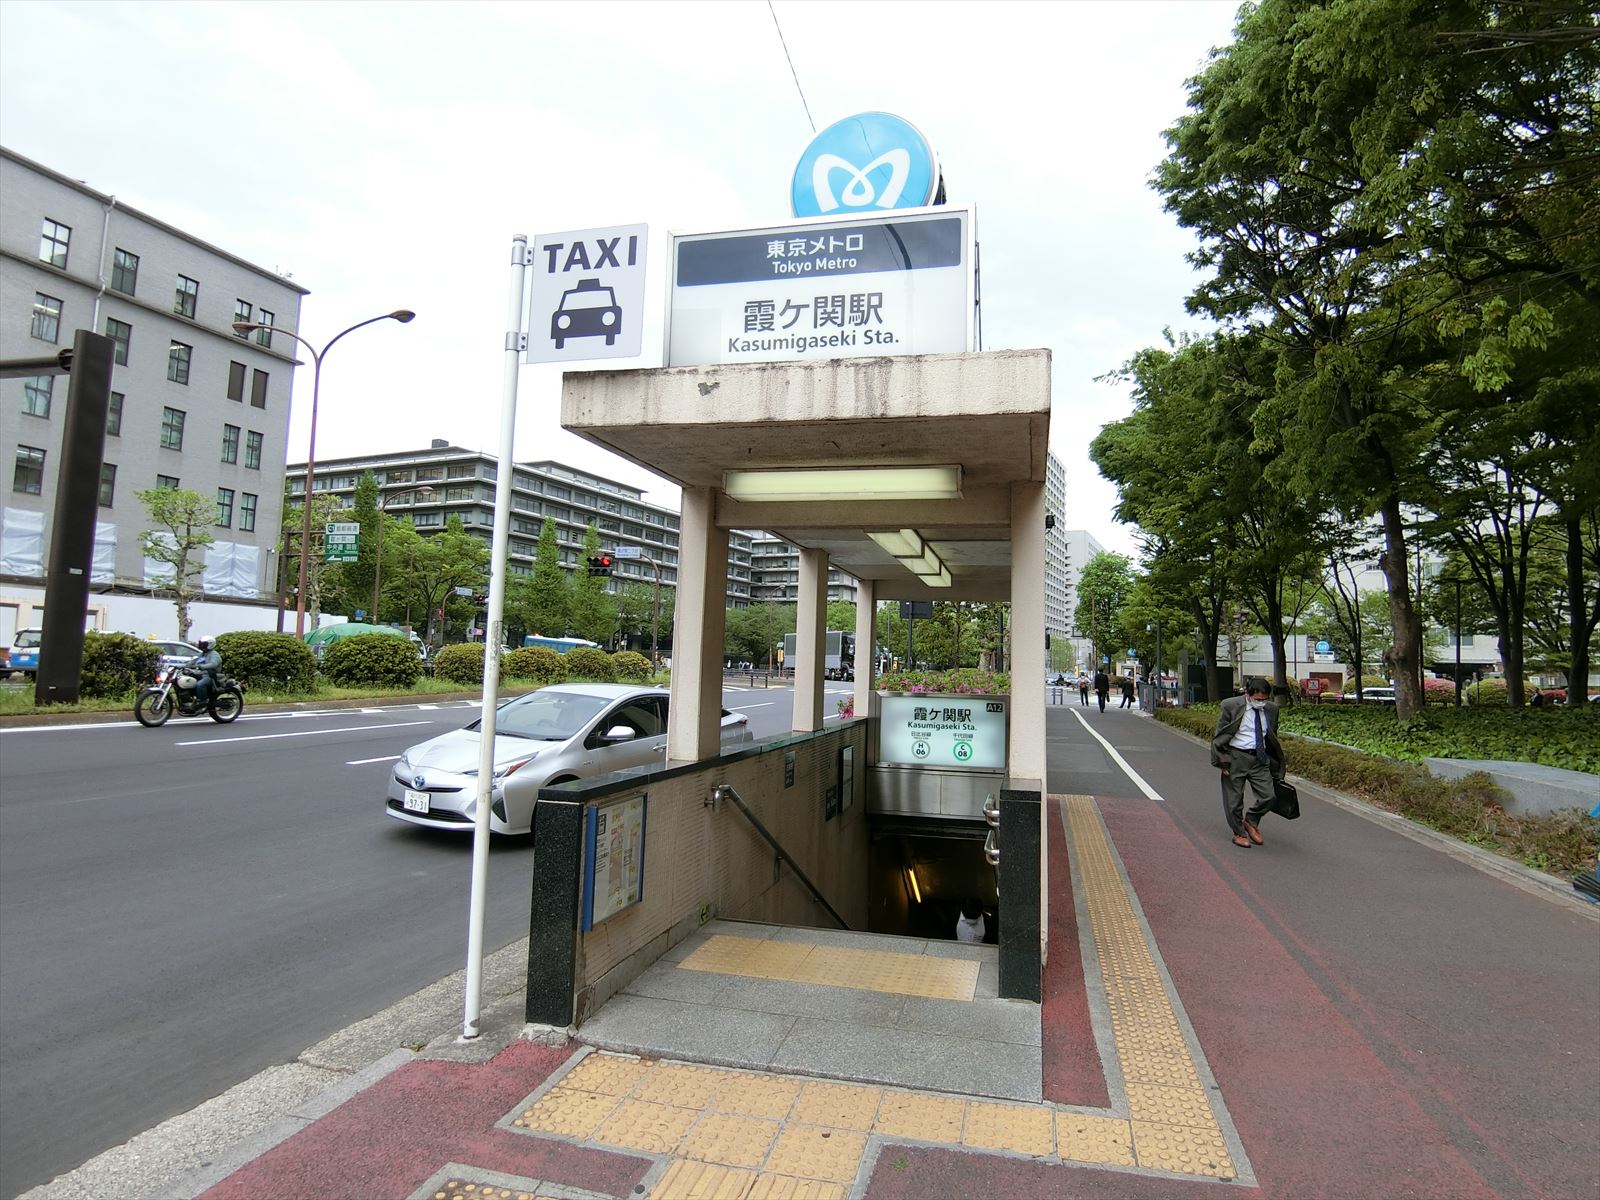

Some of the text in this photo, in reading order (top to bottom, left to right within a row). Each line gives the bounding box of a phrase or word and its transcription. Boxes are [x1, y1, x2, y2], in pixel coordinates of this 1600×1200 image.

[543, 236, 638, 273] TAXI
[766, 234, 864, 259] 東京メトロ
[772, 257, 857, 275] Tokyo Metro
[728, 329, 899, 353] Kasumigaseki Sta.
[986, 703, 1002, 711] A12
[907, 721, 977, 731] Kasumigaseki Sta.
